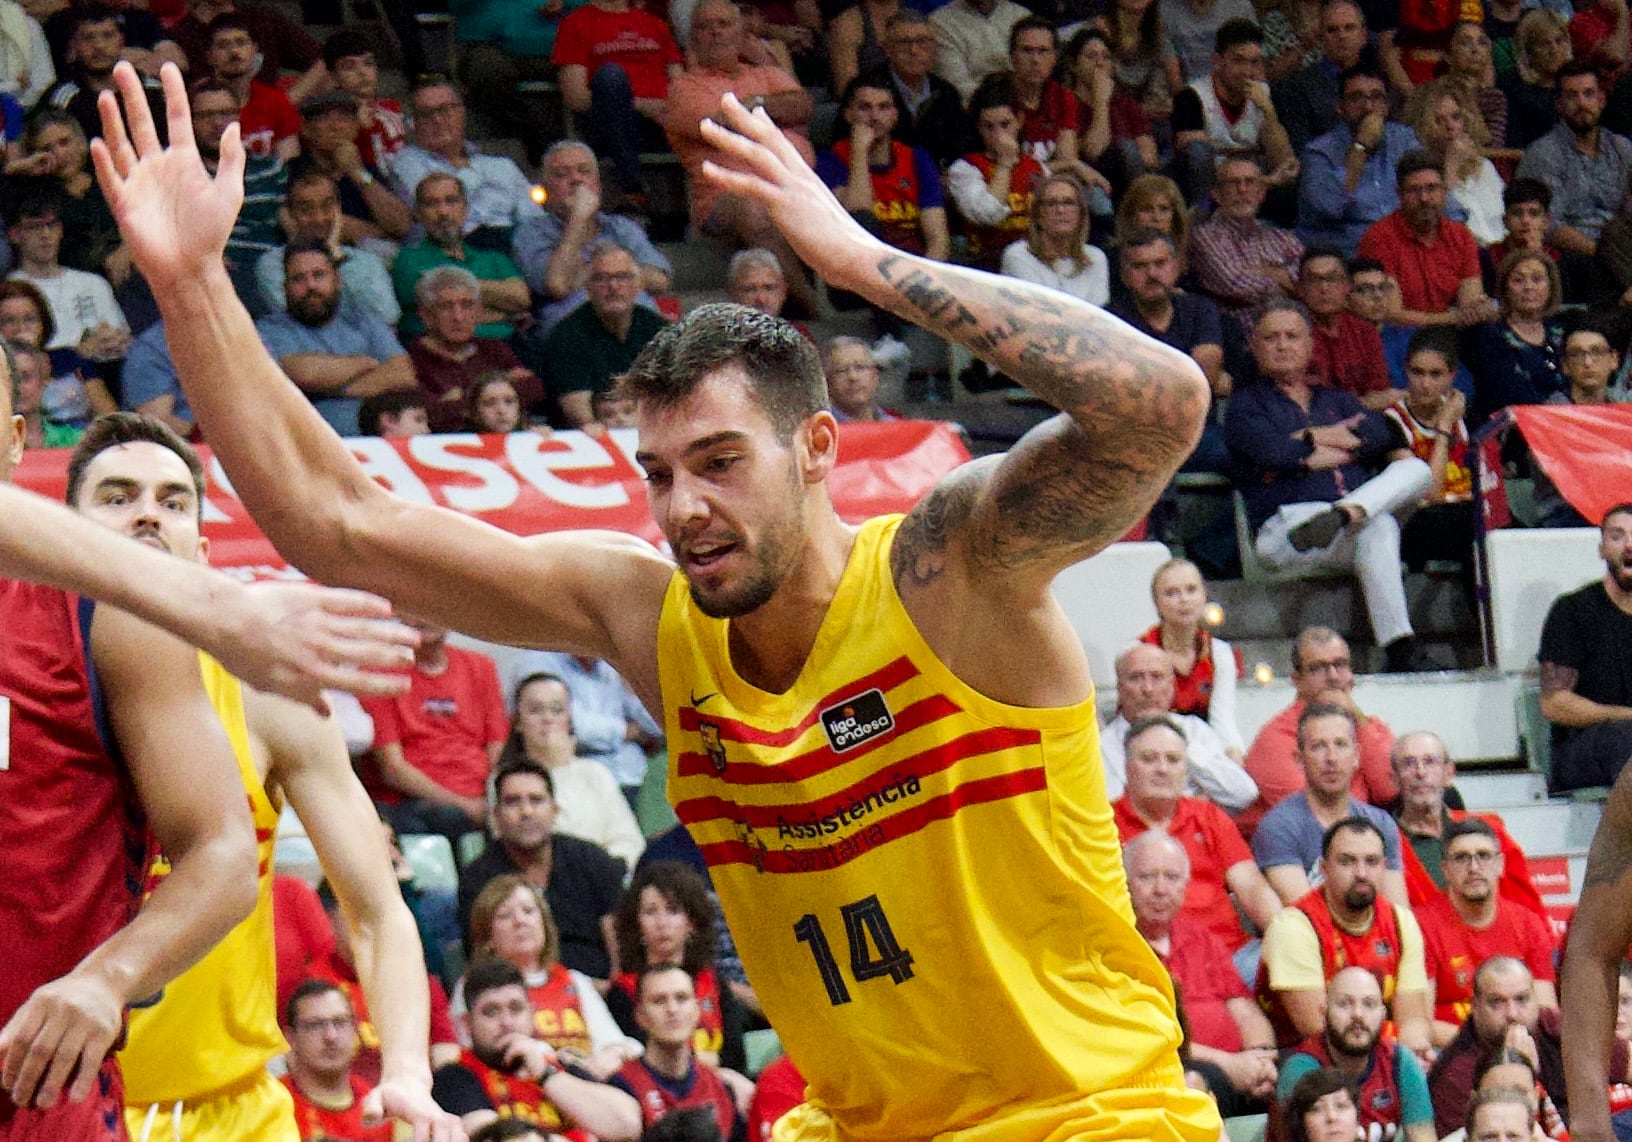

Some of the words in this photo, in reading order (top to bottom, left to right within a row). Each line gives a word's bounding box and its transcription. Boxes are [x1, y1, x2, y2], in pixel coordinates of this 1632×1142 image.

[829, 717, 856, 735] liga
[836, 716, 889, 746] endesa
[793, 894, 915, 1006] 14
